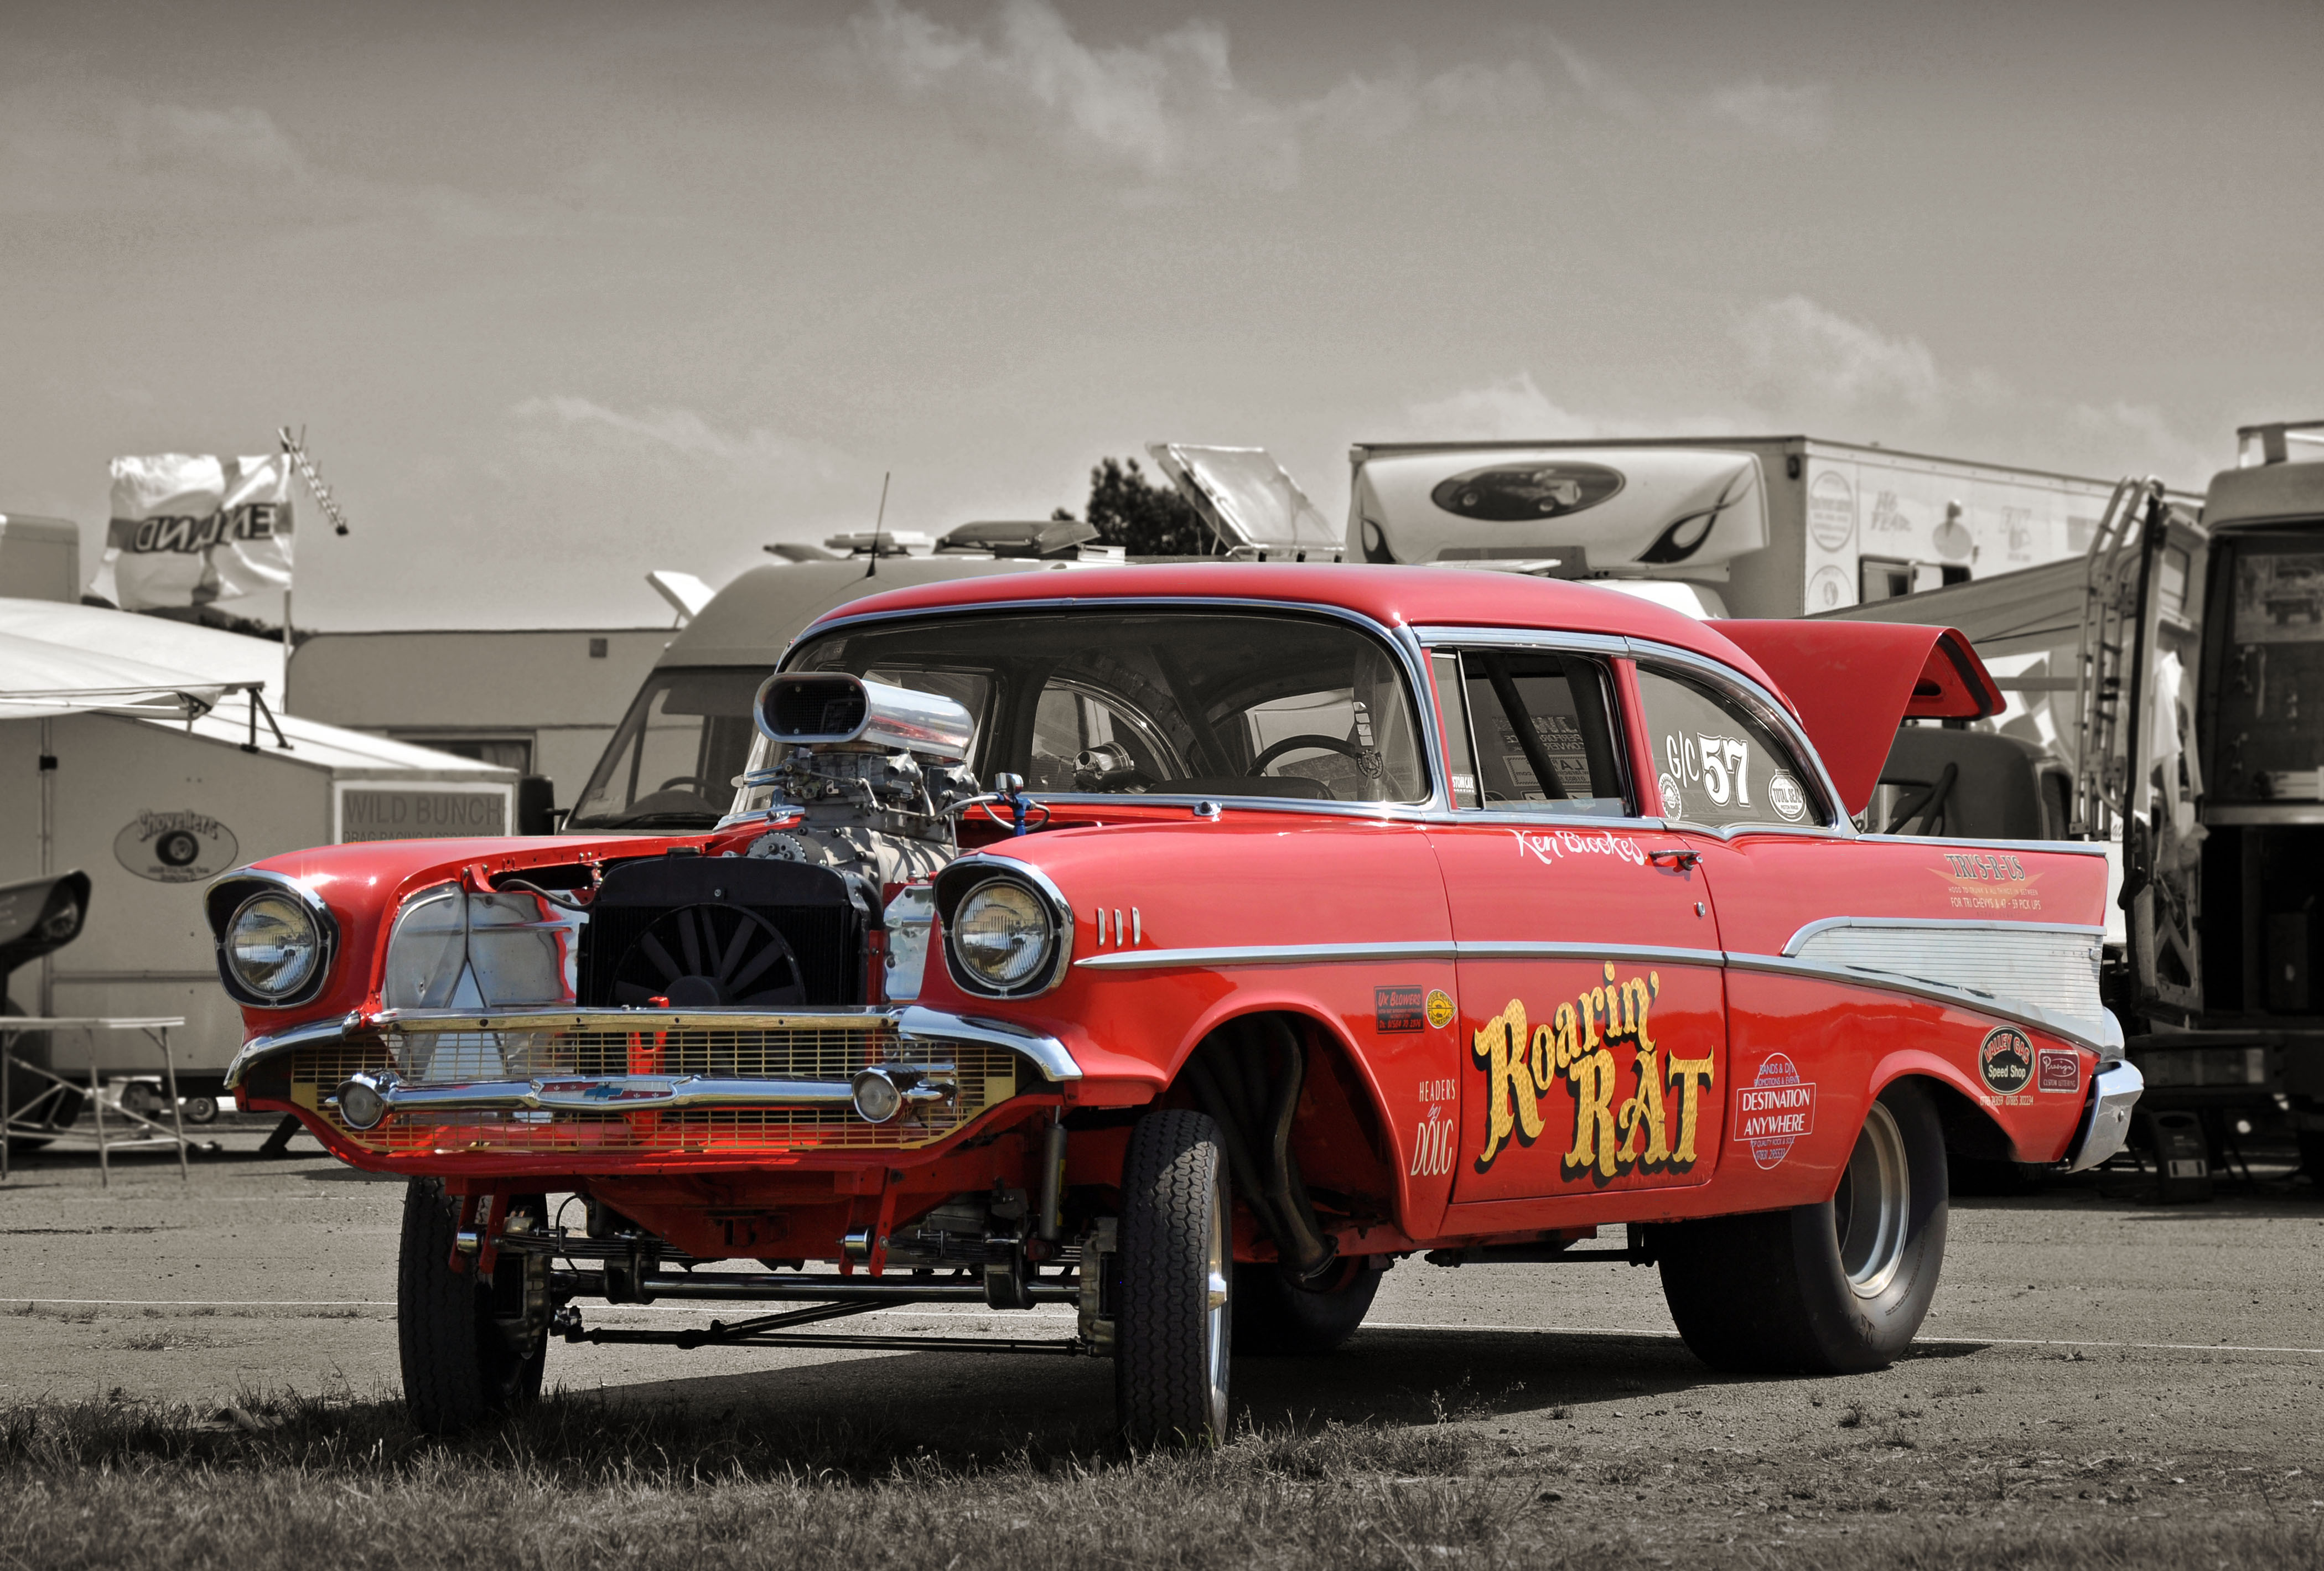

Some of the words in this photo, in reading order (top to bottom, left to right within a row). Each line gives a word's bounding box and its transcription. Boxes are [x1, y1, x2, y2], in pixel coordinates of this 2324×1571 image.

[1666, 730, 1699, 789] G/C
[1697, 732, 1751, 807] 57
[1465, 776, 1474, 789] CAR
[1772, 788, 1788, 803] TOTAL
[1788, 788, 1803, 803] SEAL
[345, 795, 407, 824] WILD
[417, 796, 502, 826] BUNCH
[344, 831, 376, 842] DRAG
[1505, 828, 1564, 864] Ken
[1950, 897, 1963, 908] FOR
[1963, 897, 1972, 908] TRI
[1973, 898, 1994, 908] CHEVYS
[2020, 899, 2031, 910] PICK
[2031, 900, 2041, 910] UPS
[1984, 1033, 2012, 1063] VALLEY
[2014, 1036, 2030, 1065] GAS
[1473, 960, 1660, 1165] Roarin'
[1988, 1064, 2009, 1080] Speed
[2010, 1065, 2026, 1080] Shop
[1419, 1079, 1455, 1102] HEADERS
[1742, 1088, 1811, 1112] DESTINATION
[1427, 1103, 1441, 1123] by
[1564, 1045, 1714, 1179] RAT
[1744, 1113, 1806, 1137] ANYWHERE
[1410, 1118, 1454, 1176] DOUG
